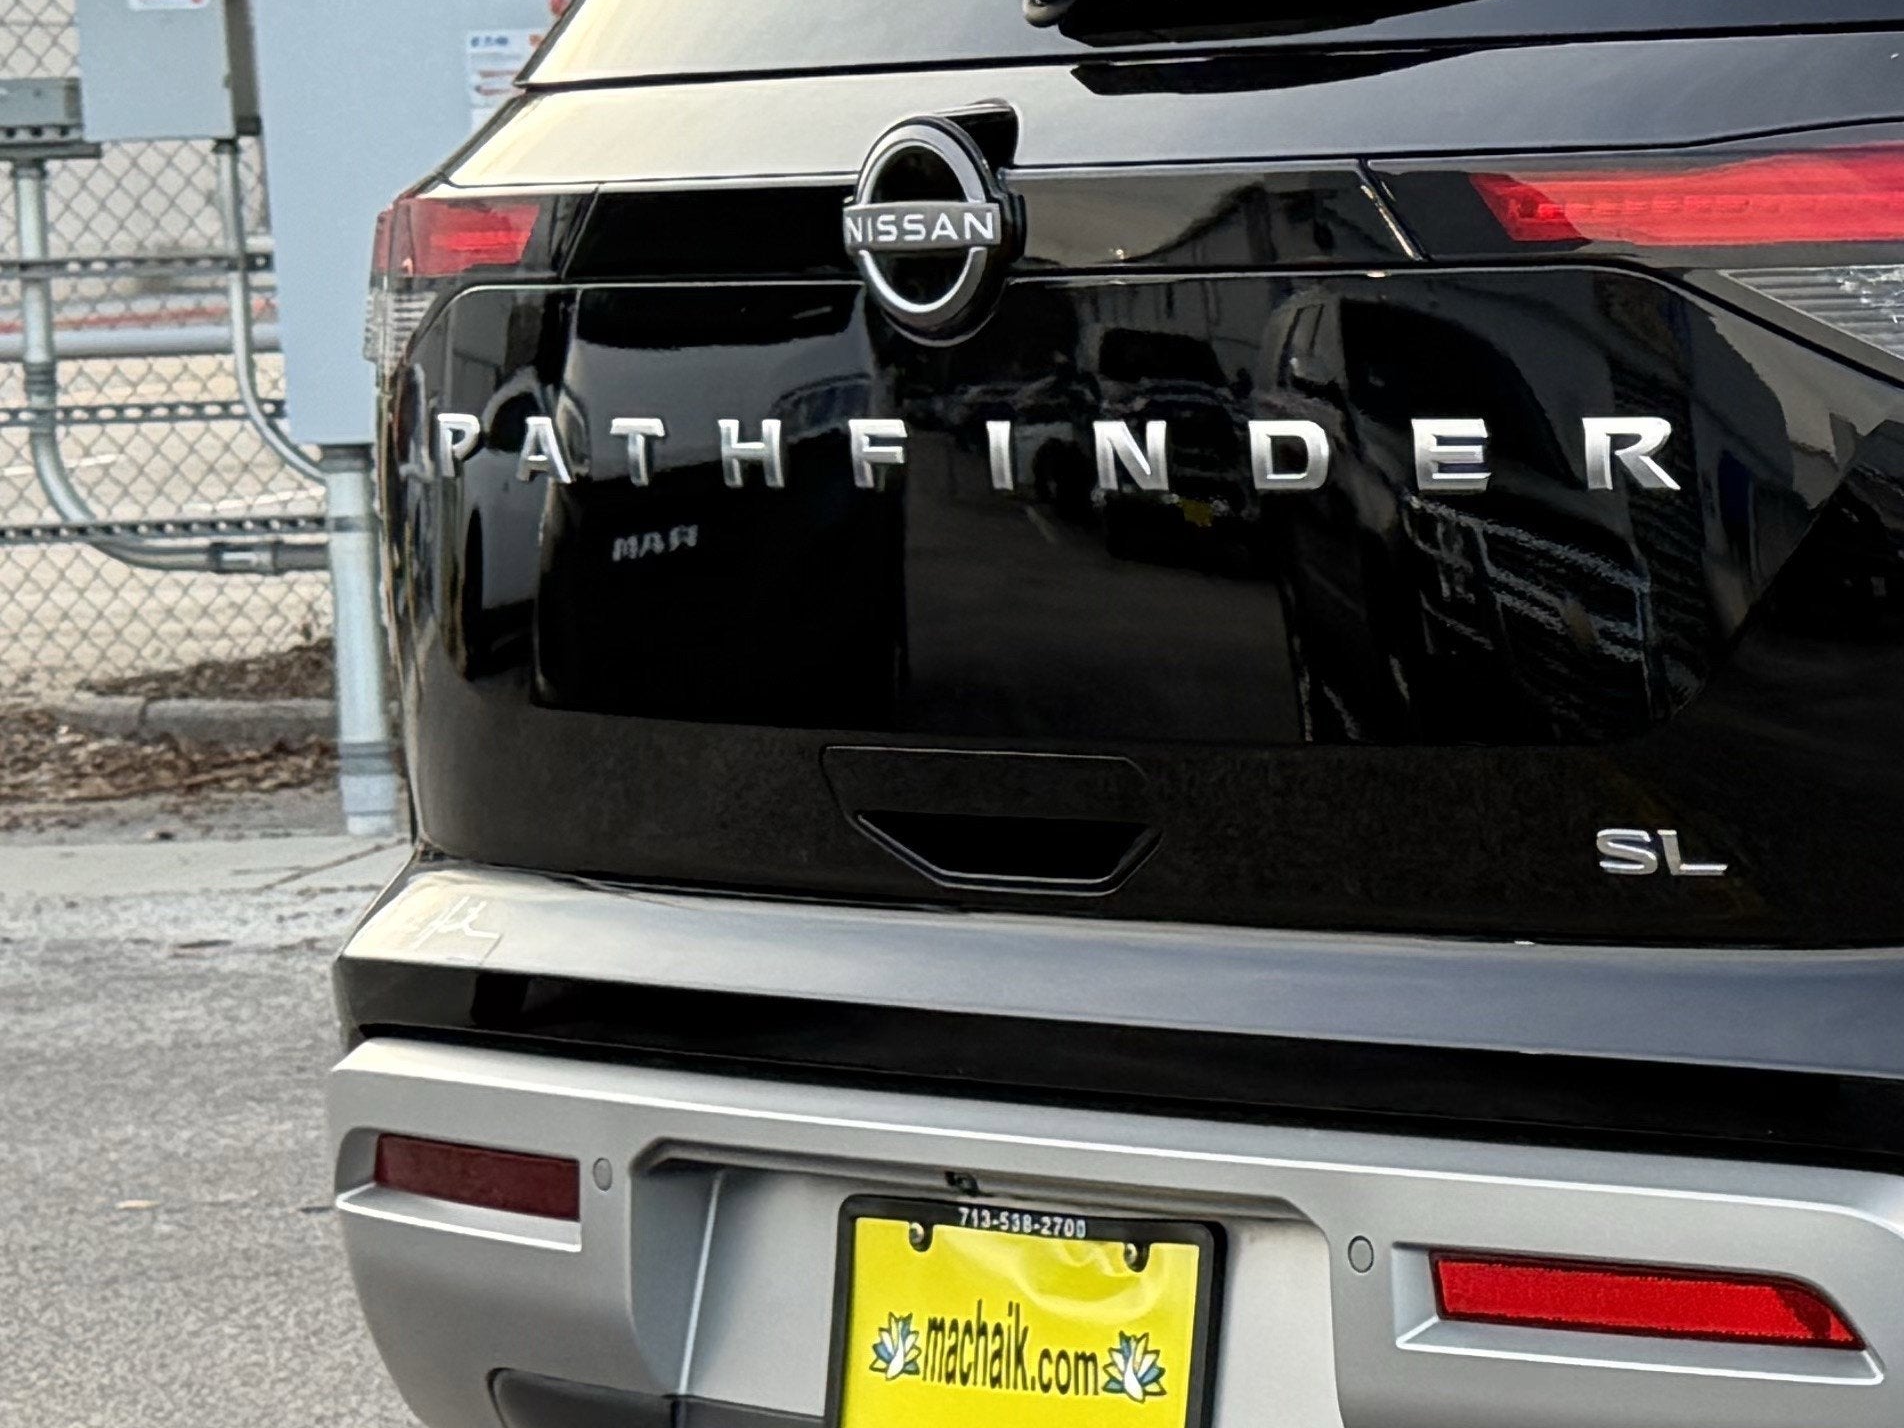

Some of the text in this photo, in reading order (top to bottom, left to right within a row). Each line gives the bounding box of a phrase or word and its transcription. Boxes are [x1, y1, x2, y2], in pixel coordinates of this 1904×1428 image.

[846, 212, 994, 243] NISSAN
[437, 413, 1681, 490] PATHFINDER
[1597, 828, 1728, 876] SL
[921, 1298, 1100, 1396] machaik.com
